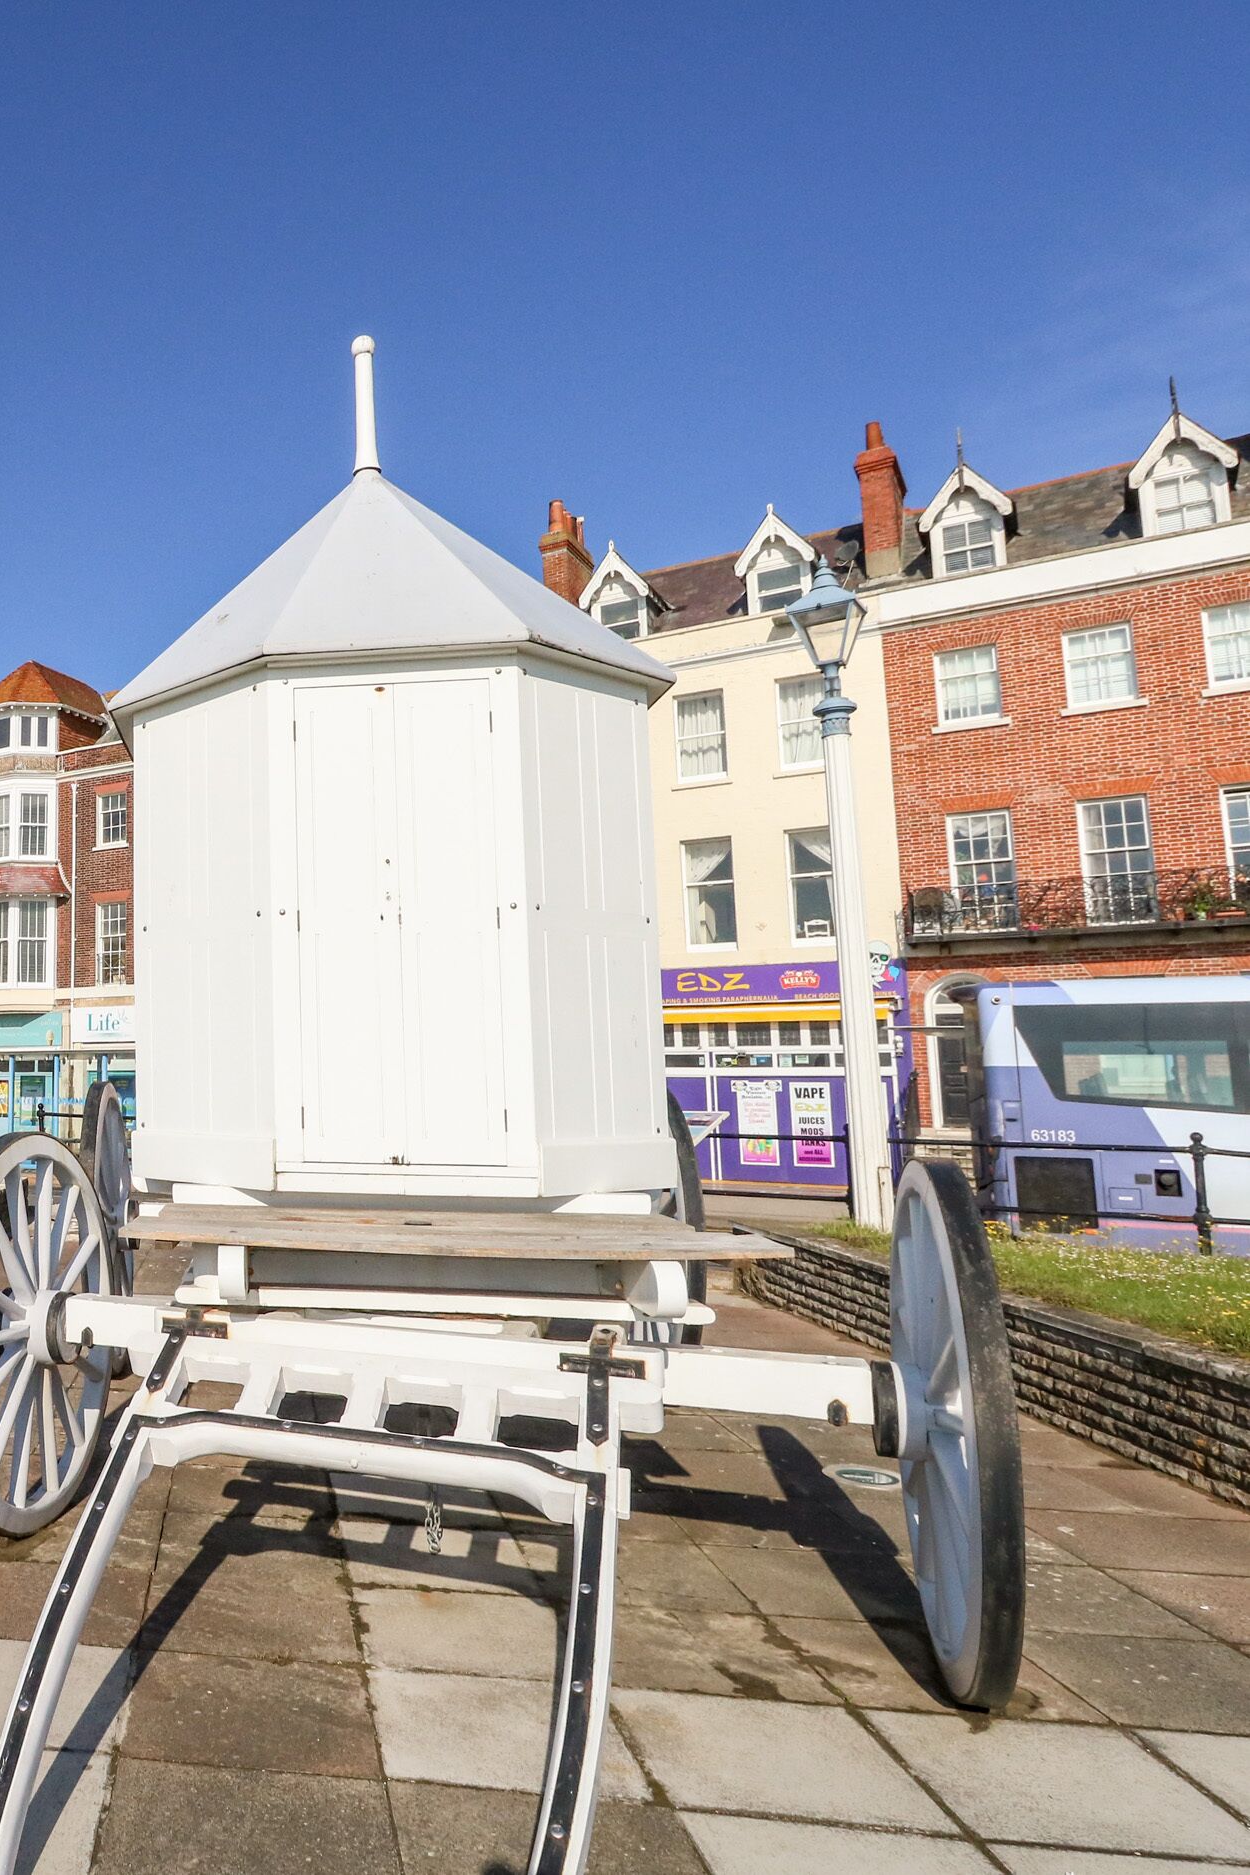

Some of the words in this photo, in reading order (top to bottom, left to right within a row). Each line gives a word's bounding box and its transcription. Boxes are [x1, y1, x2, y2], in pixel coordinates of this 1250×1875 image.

[676, 972, 750, 992] EDZ
[818, 991, 841, 999] GOOD
[88, 1013, 120, 1031] Life
[794, 1087, 825, 1099] VAPE
[799, 1117, 825, 1125] JUICES
[801, 1128, 824, 1136] MODS
[1031, 1129, 1076, 1142] 63183
